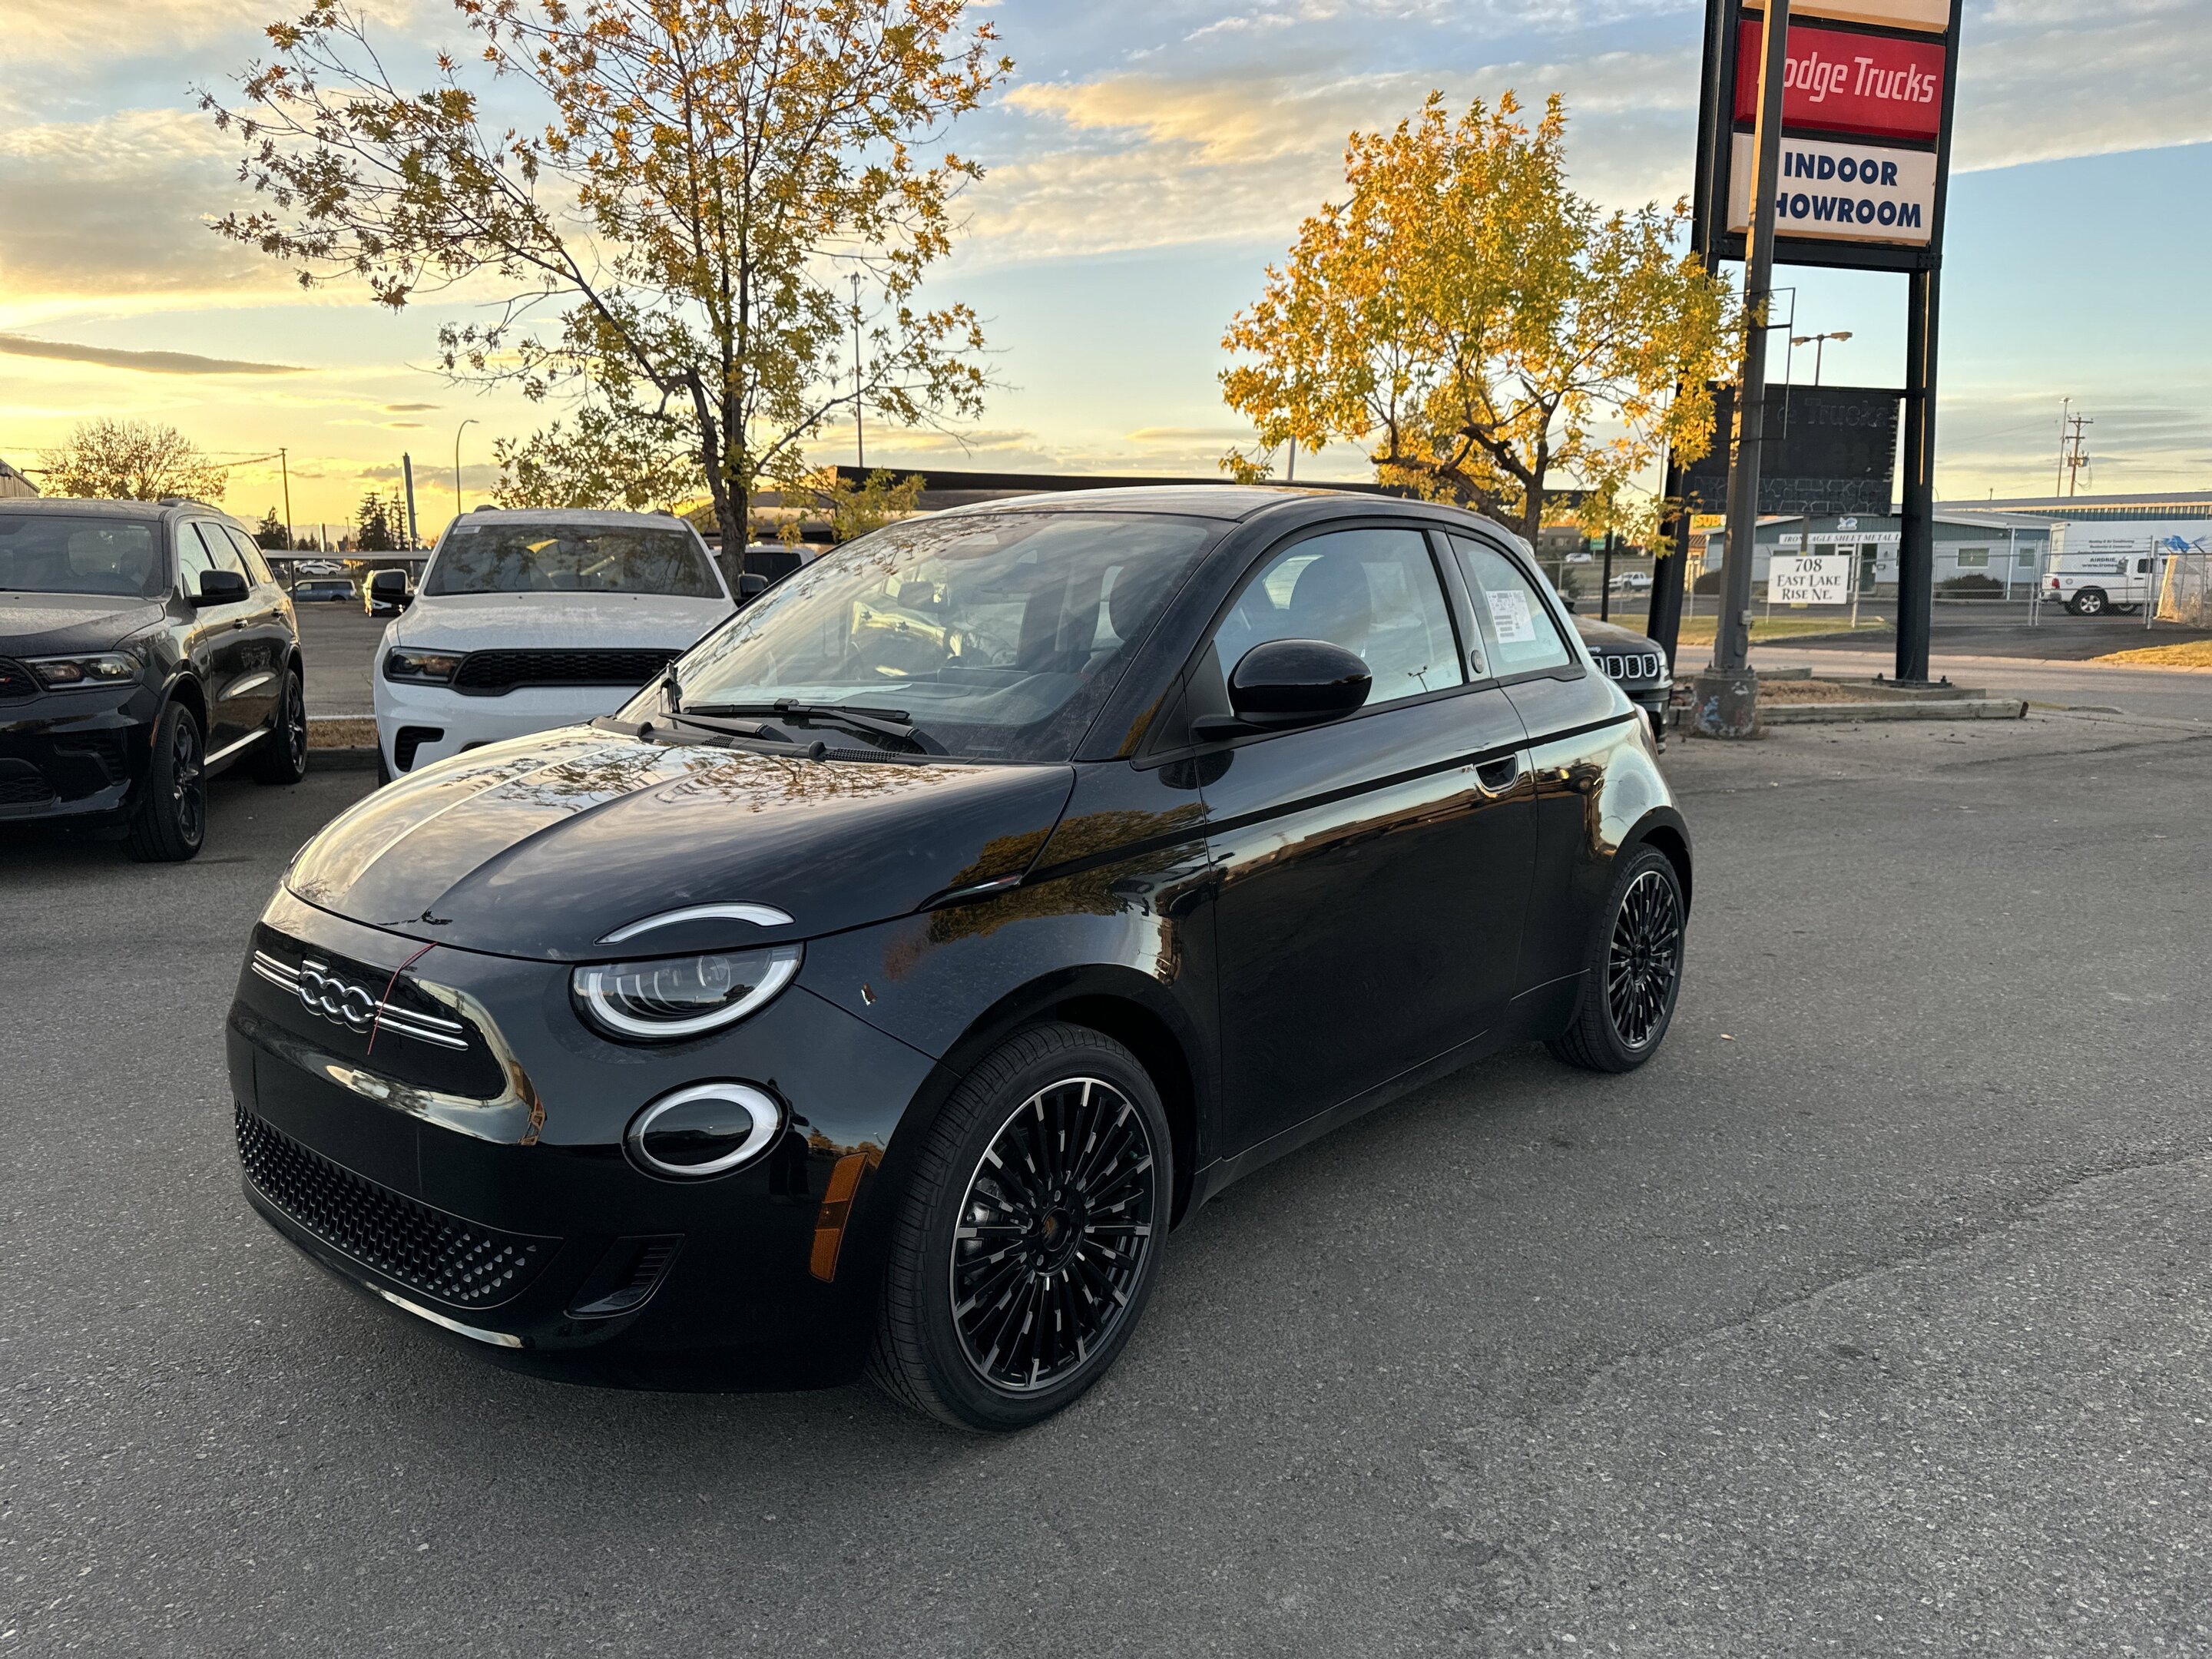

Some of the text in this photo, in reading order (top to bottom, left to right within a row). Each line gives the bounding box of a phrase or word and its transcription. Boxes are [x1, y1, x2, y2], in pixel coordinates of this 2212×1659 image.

[1783, 51, 1936, 103] odge Trucks
[1783, 151, 1897, 187] INDOOR
[1775, 192, 1921, 228] HOWROOM
[1796, 558, 1823, 572] 708
[1777, 574, 1841, 587] EAST LAKE
[1782, 588, 1808, 600] RISE
